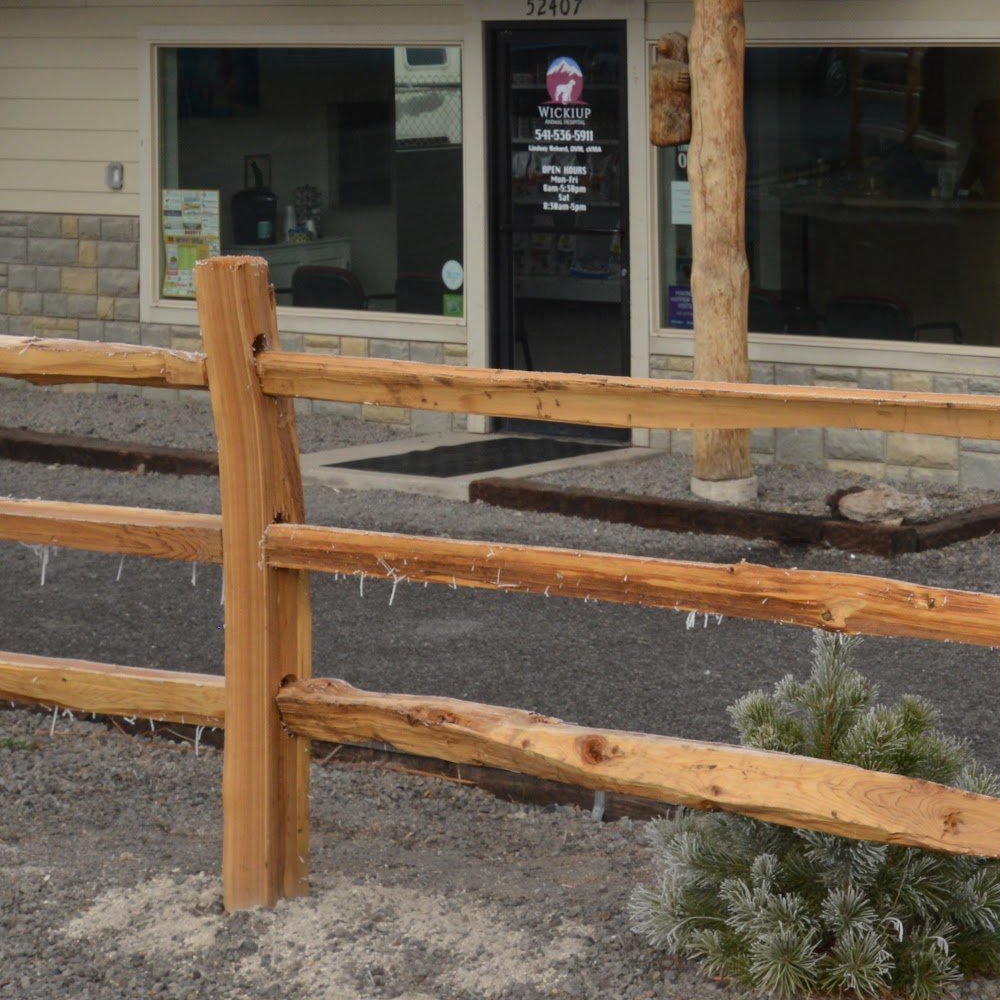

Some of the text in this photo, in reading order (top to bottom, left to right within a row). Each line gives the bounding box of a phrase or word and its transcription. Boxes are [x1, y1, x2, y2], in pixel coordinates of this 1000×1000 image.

[538, 106, 592, 119] WICKIUP
[534, 129, 594, 142] 541-536-5911
[542, 165, 587, 175] OPEN HOURS
[550, 175, 579, 184] Mon-Fri
[558, 193, 570, 202] Sat
